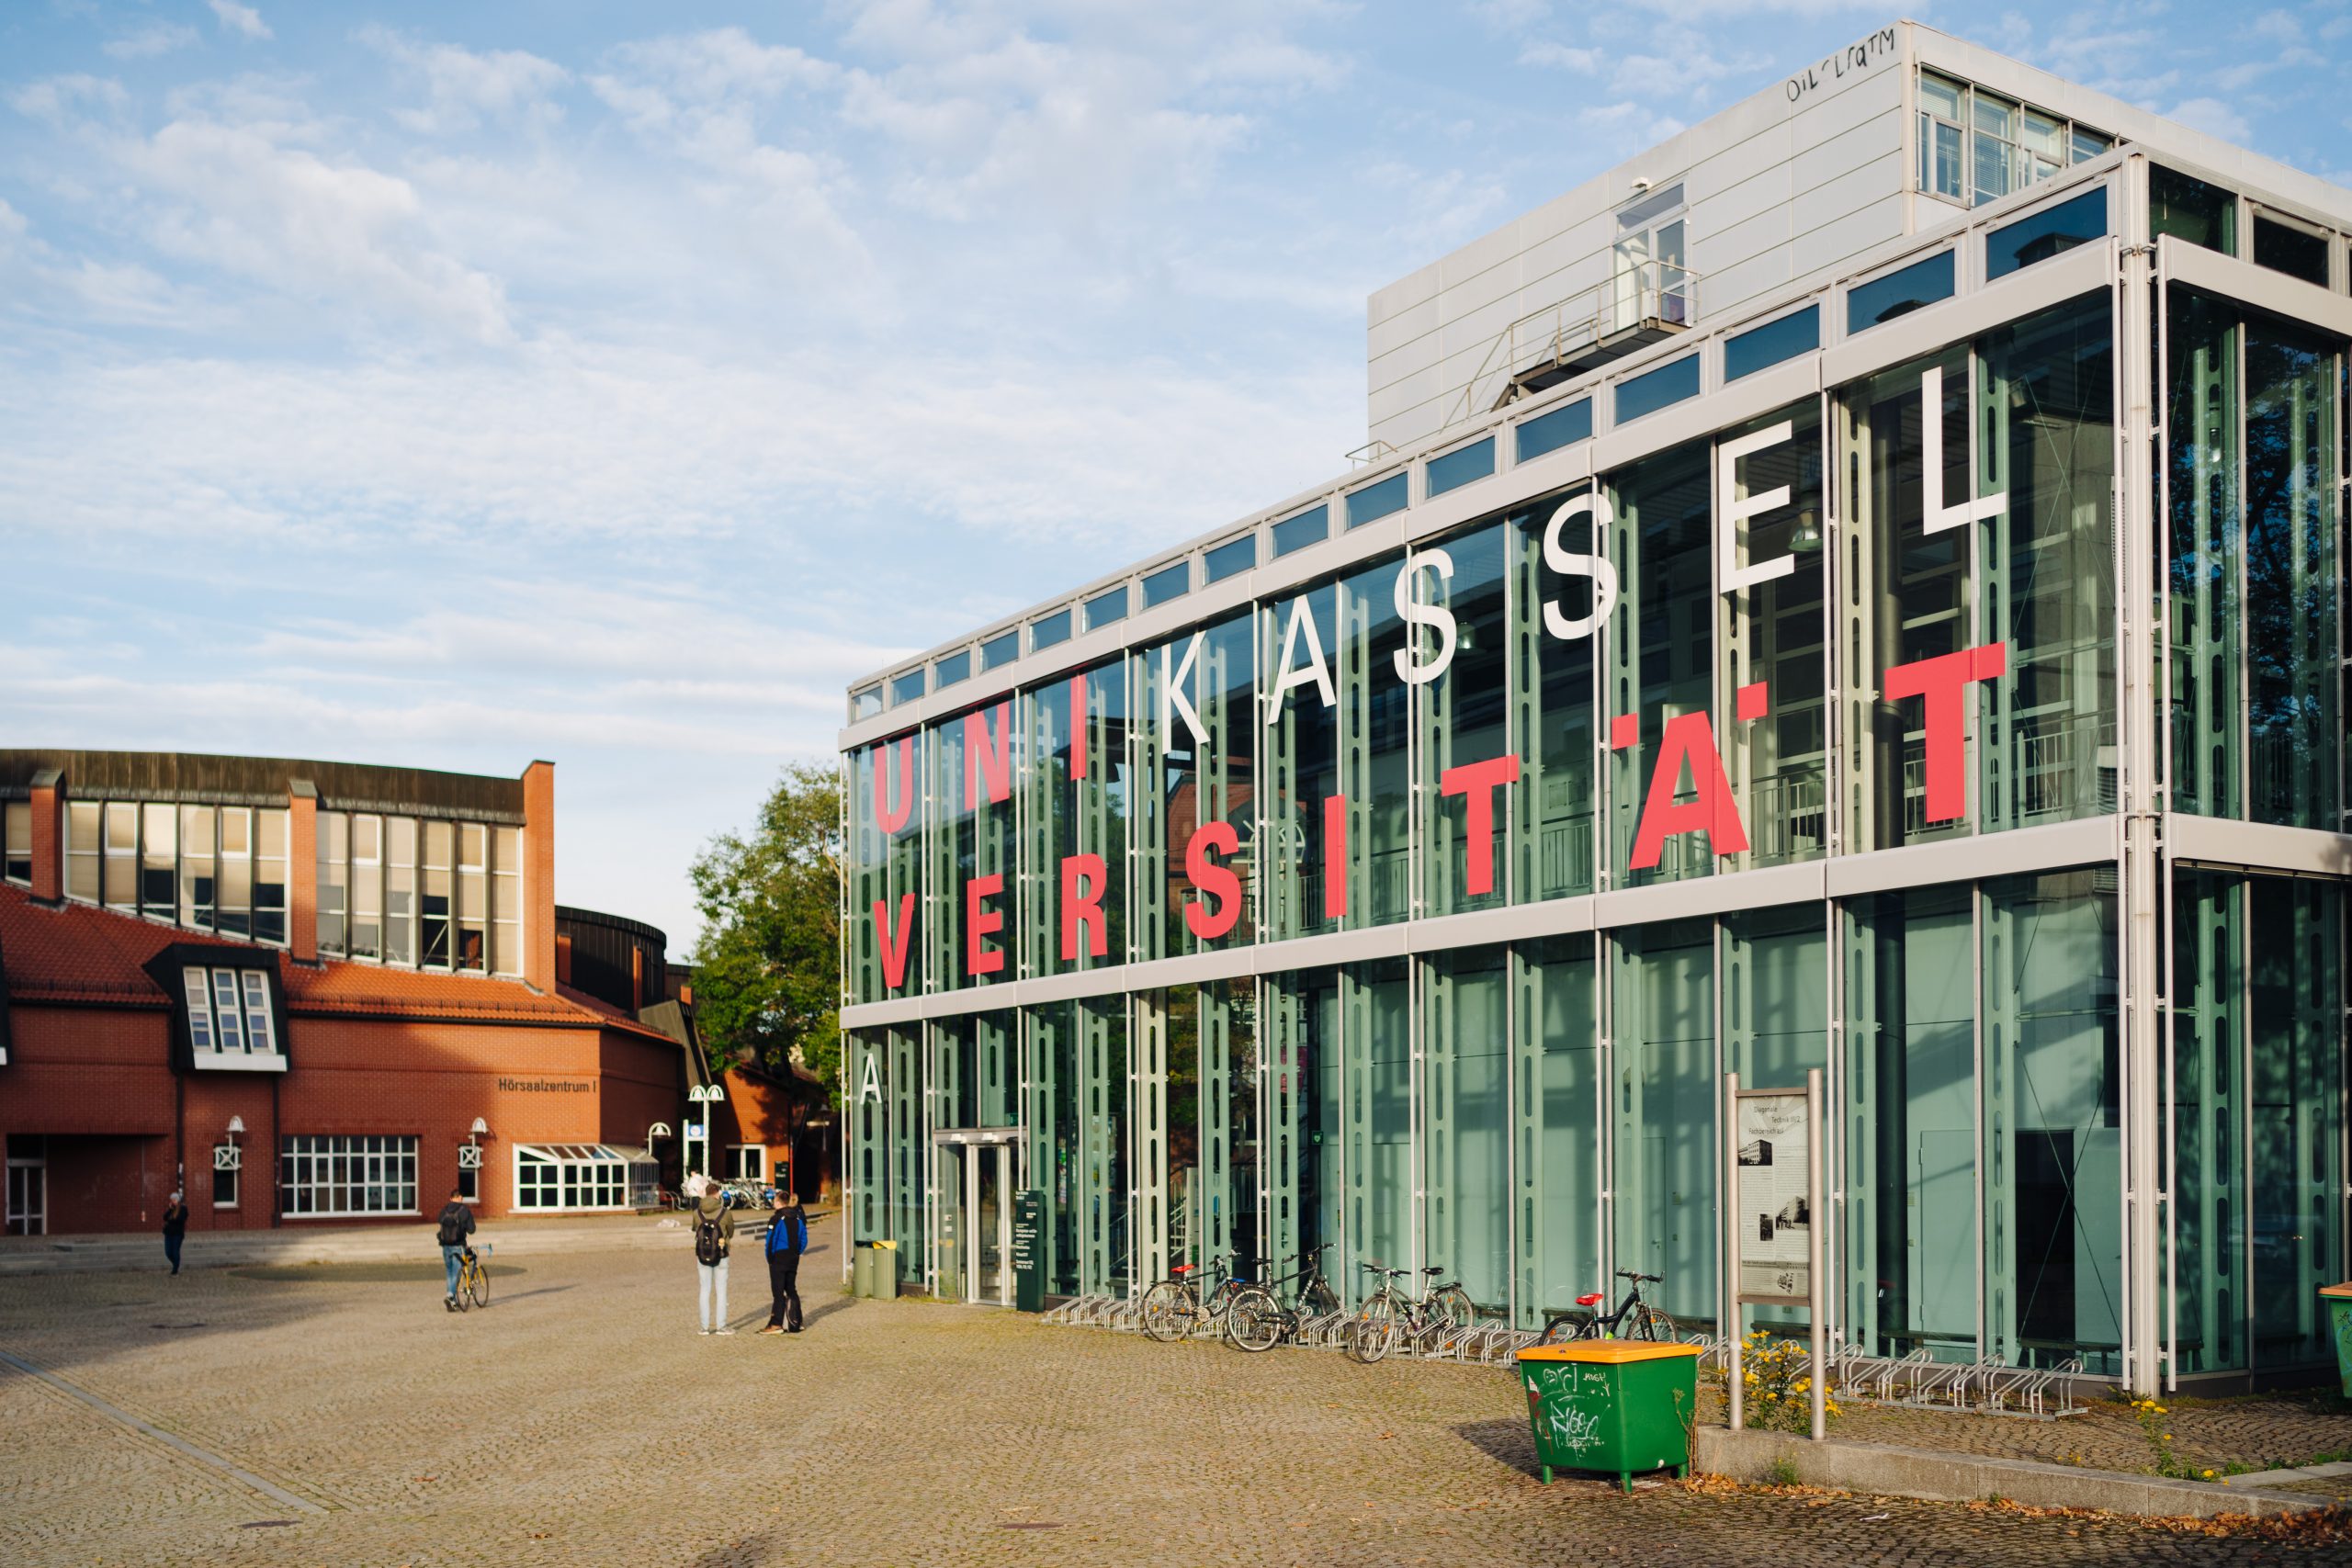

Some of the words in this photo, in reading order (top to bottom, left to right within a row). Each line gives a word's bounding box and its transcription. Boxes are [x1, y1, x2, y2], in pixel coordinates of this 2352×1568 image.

[874, 661, 1088, 834] UNI
[1160, 367, 2007, 757] KASSEL
[499, 1077, 589, 1093] Hörsaalzentrum
[860, 1053, 882, 1105] A
